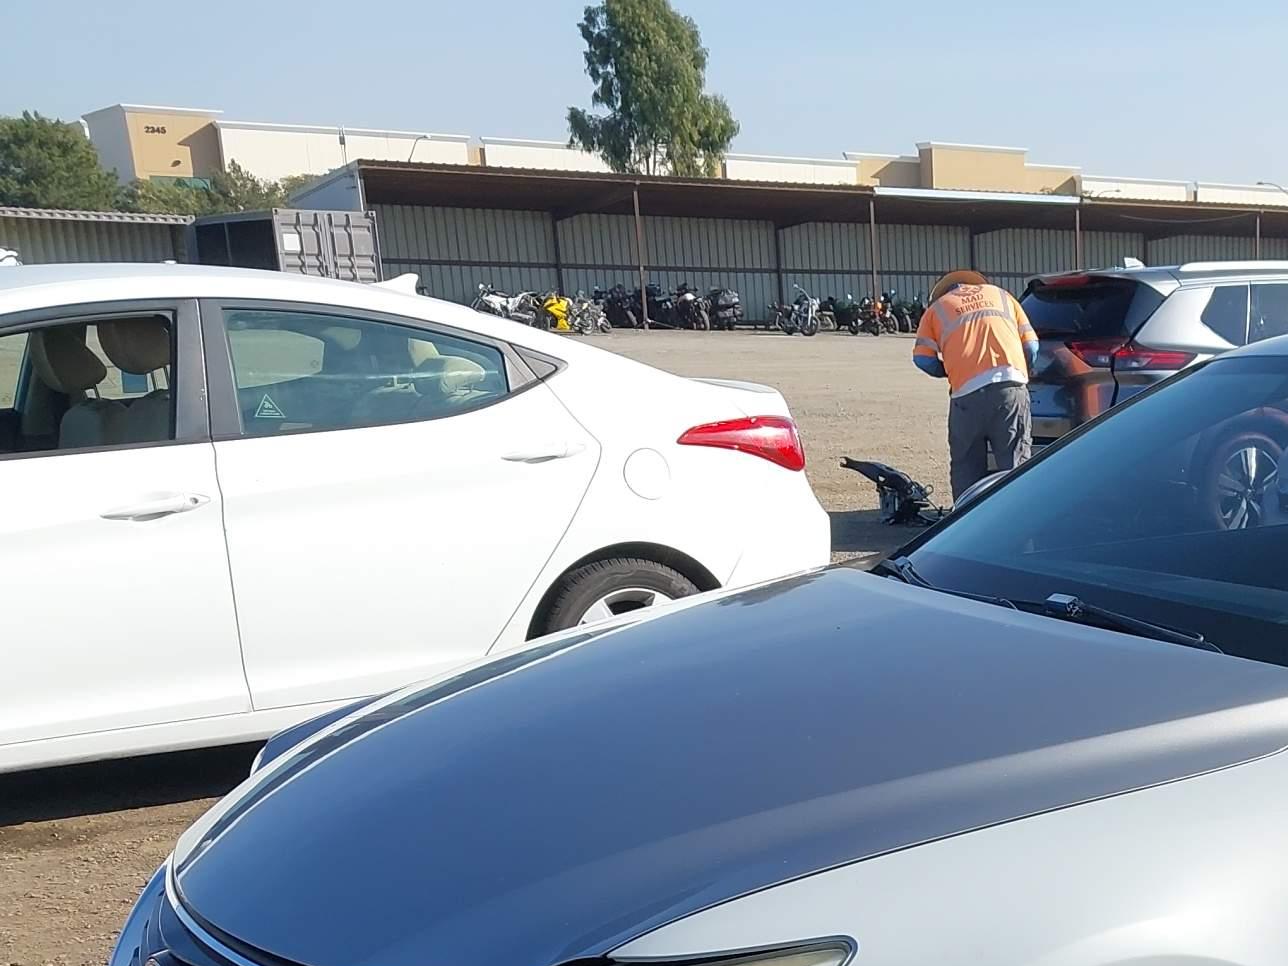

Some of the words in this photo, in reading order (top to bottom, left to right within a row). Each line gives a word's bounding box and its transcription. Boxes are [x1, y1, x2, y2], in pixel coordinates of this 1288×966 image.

[144, 125, 166, 134] 2345
[962, 293, 983, 304] MAD
[955, 300, 994, 315] SERVICES
